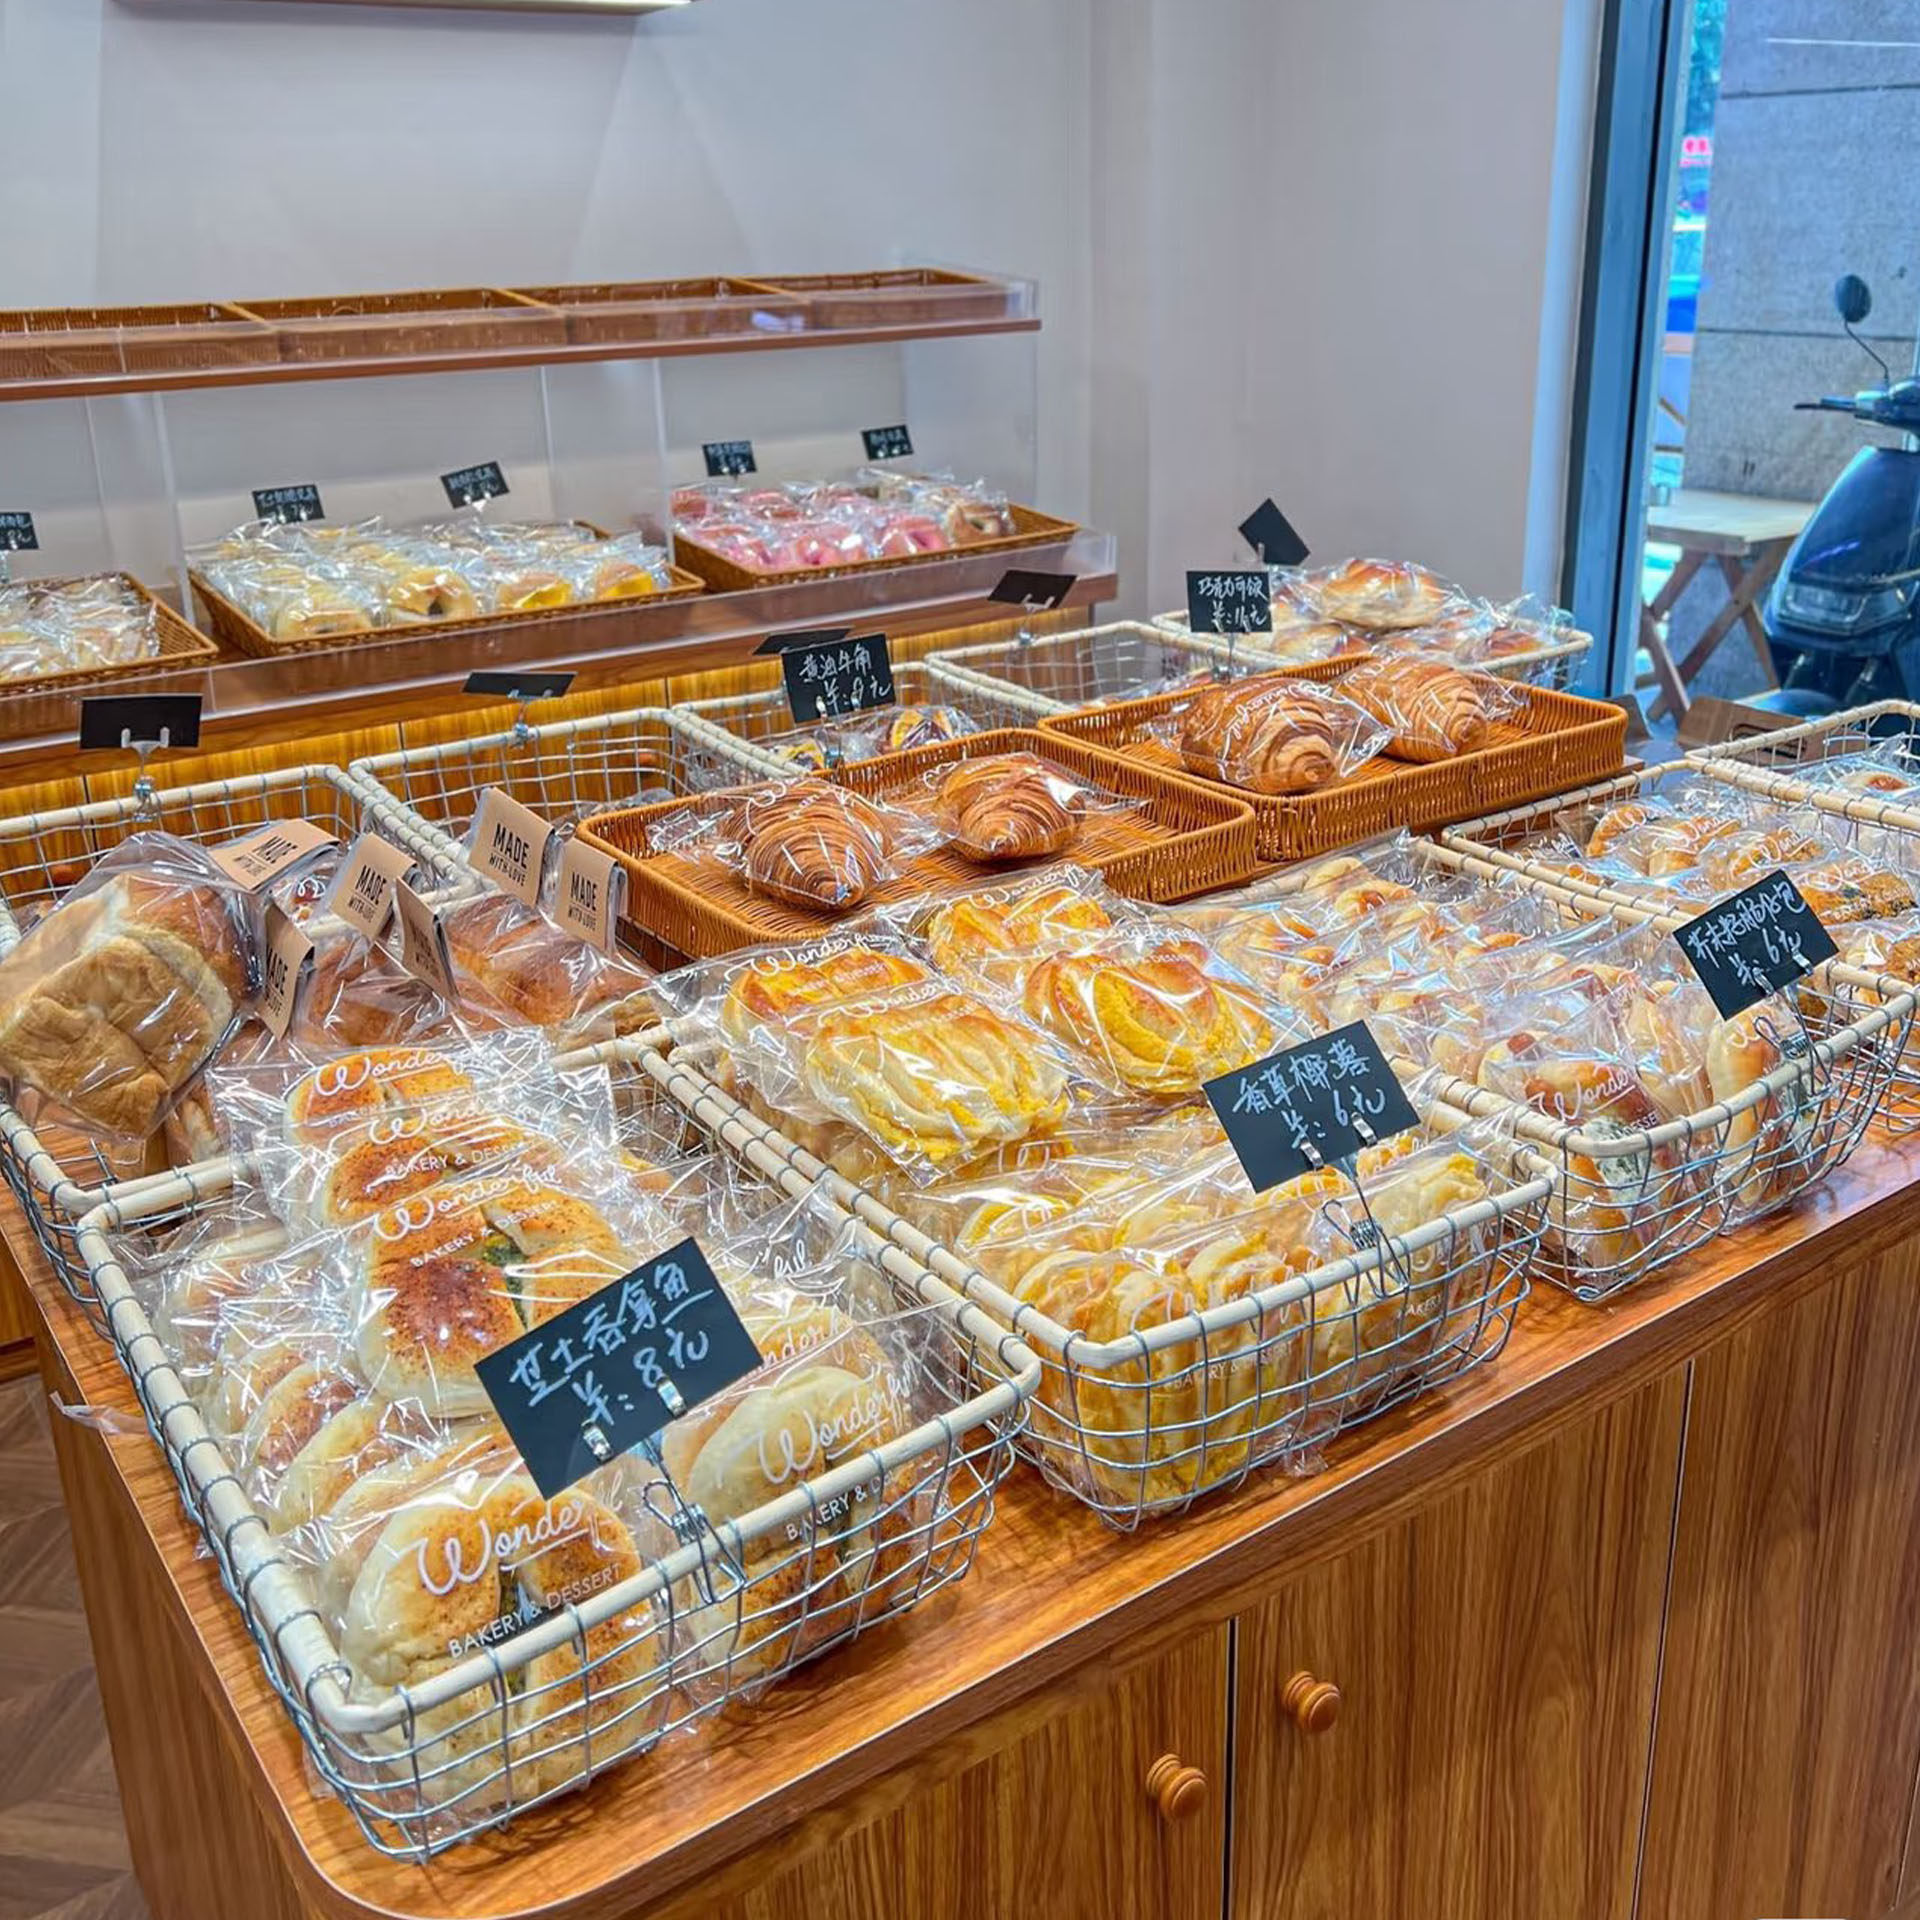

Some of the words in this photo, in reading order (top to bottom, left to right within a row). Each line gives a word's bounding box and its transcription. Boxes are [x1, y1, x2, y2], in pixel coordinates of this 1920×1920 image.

[799, 643, 872, 682] 黄油牛角
[492, 822, 530, 870] MADE
[354, 864, 388, 906] MADE
[570, 872, 598, 912] MADE
[454, 1152, 468, 1166] &
[373, 1162, 563, 1241] Wonderful
[409, 1231, 476, 1268] BAKERY
[479, 1224, 496, 1239] &
[853, 1484, 868, 1503] &
[449, 1611, 526, 1659] BAKERY
[529, 1602, 544, 1619] &
[545, 1562, 622, 1609] DESSERT
